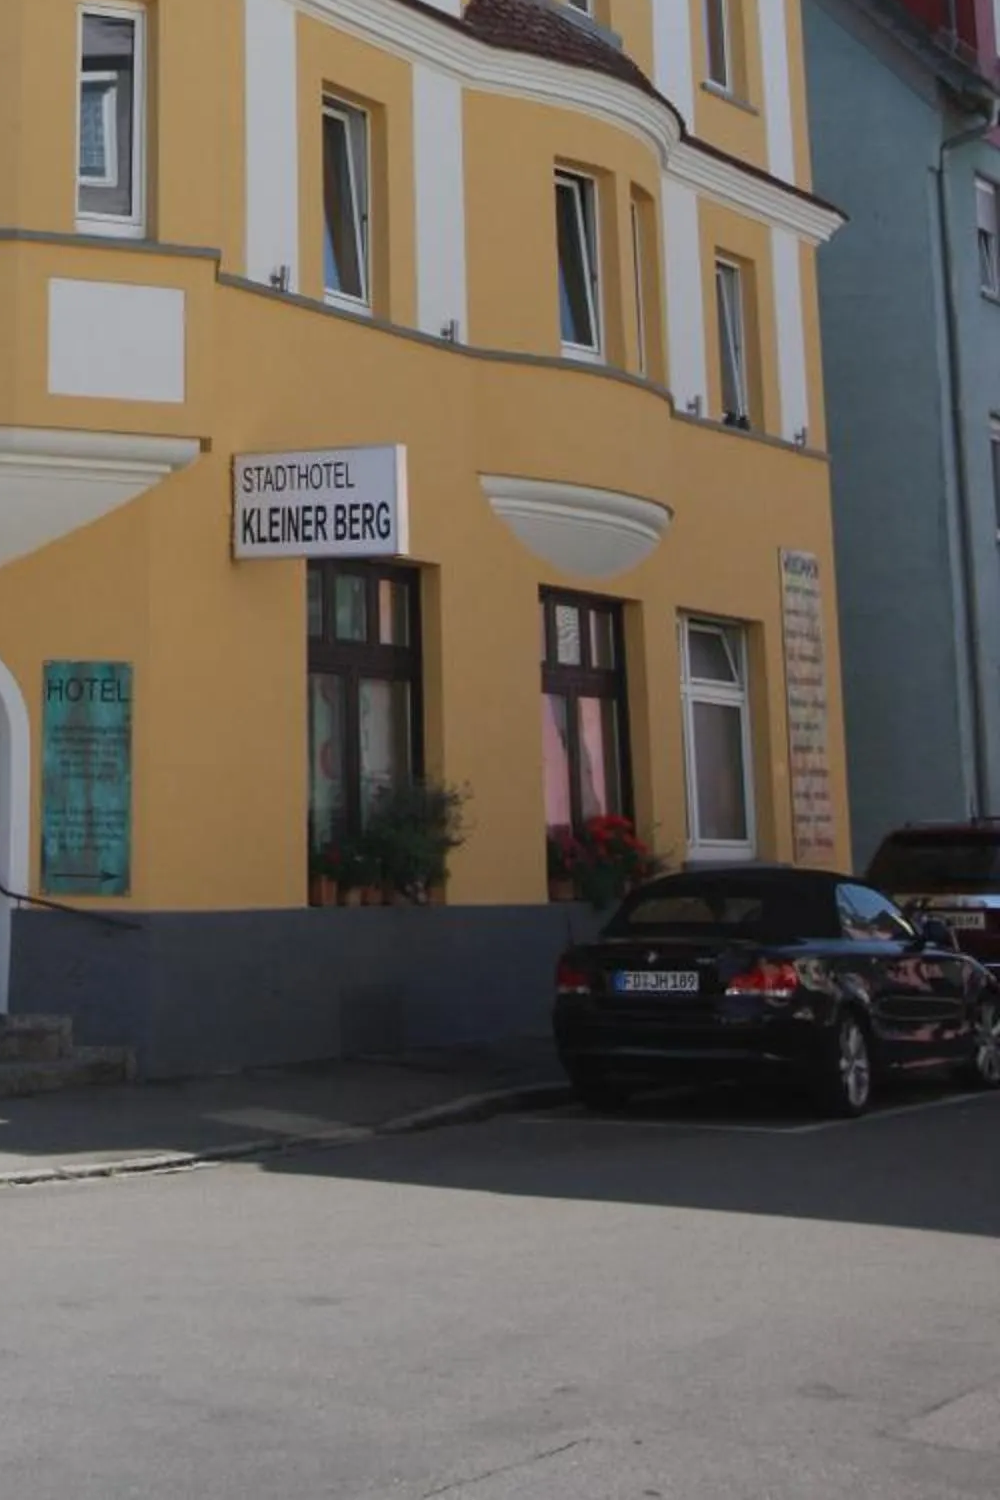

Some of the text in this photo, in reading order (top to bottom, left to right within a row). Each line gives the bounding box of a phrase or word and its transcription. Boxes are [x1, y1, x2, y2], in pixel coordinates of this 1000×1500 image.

[242, 461, 355, 493] STADTHOTEL
[242, 501, 391, 545] KLEINER BERG
[47, 677, 130, 702] HOTEL
